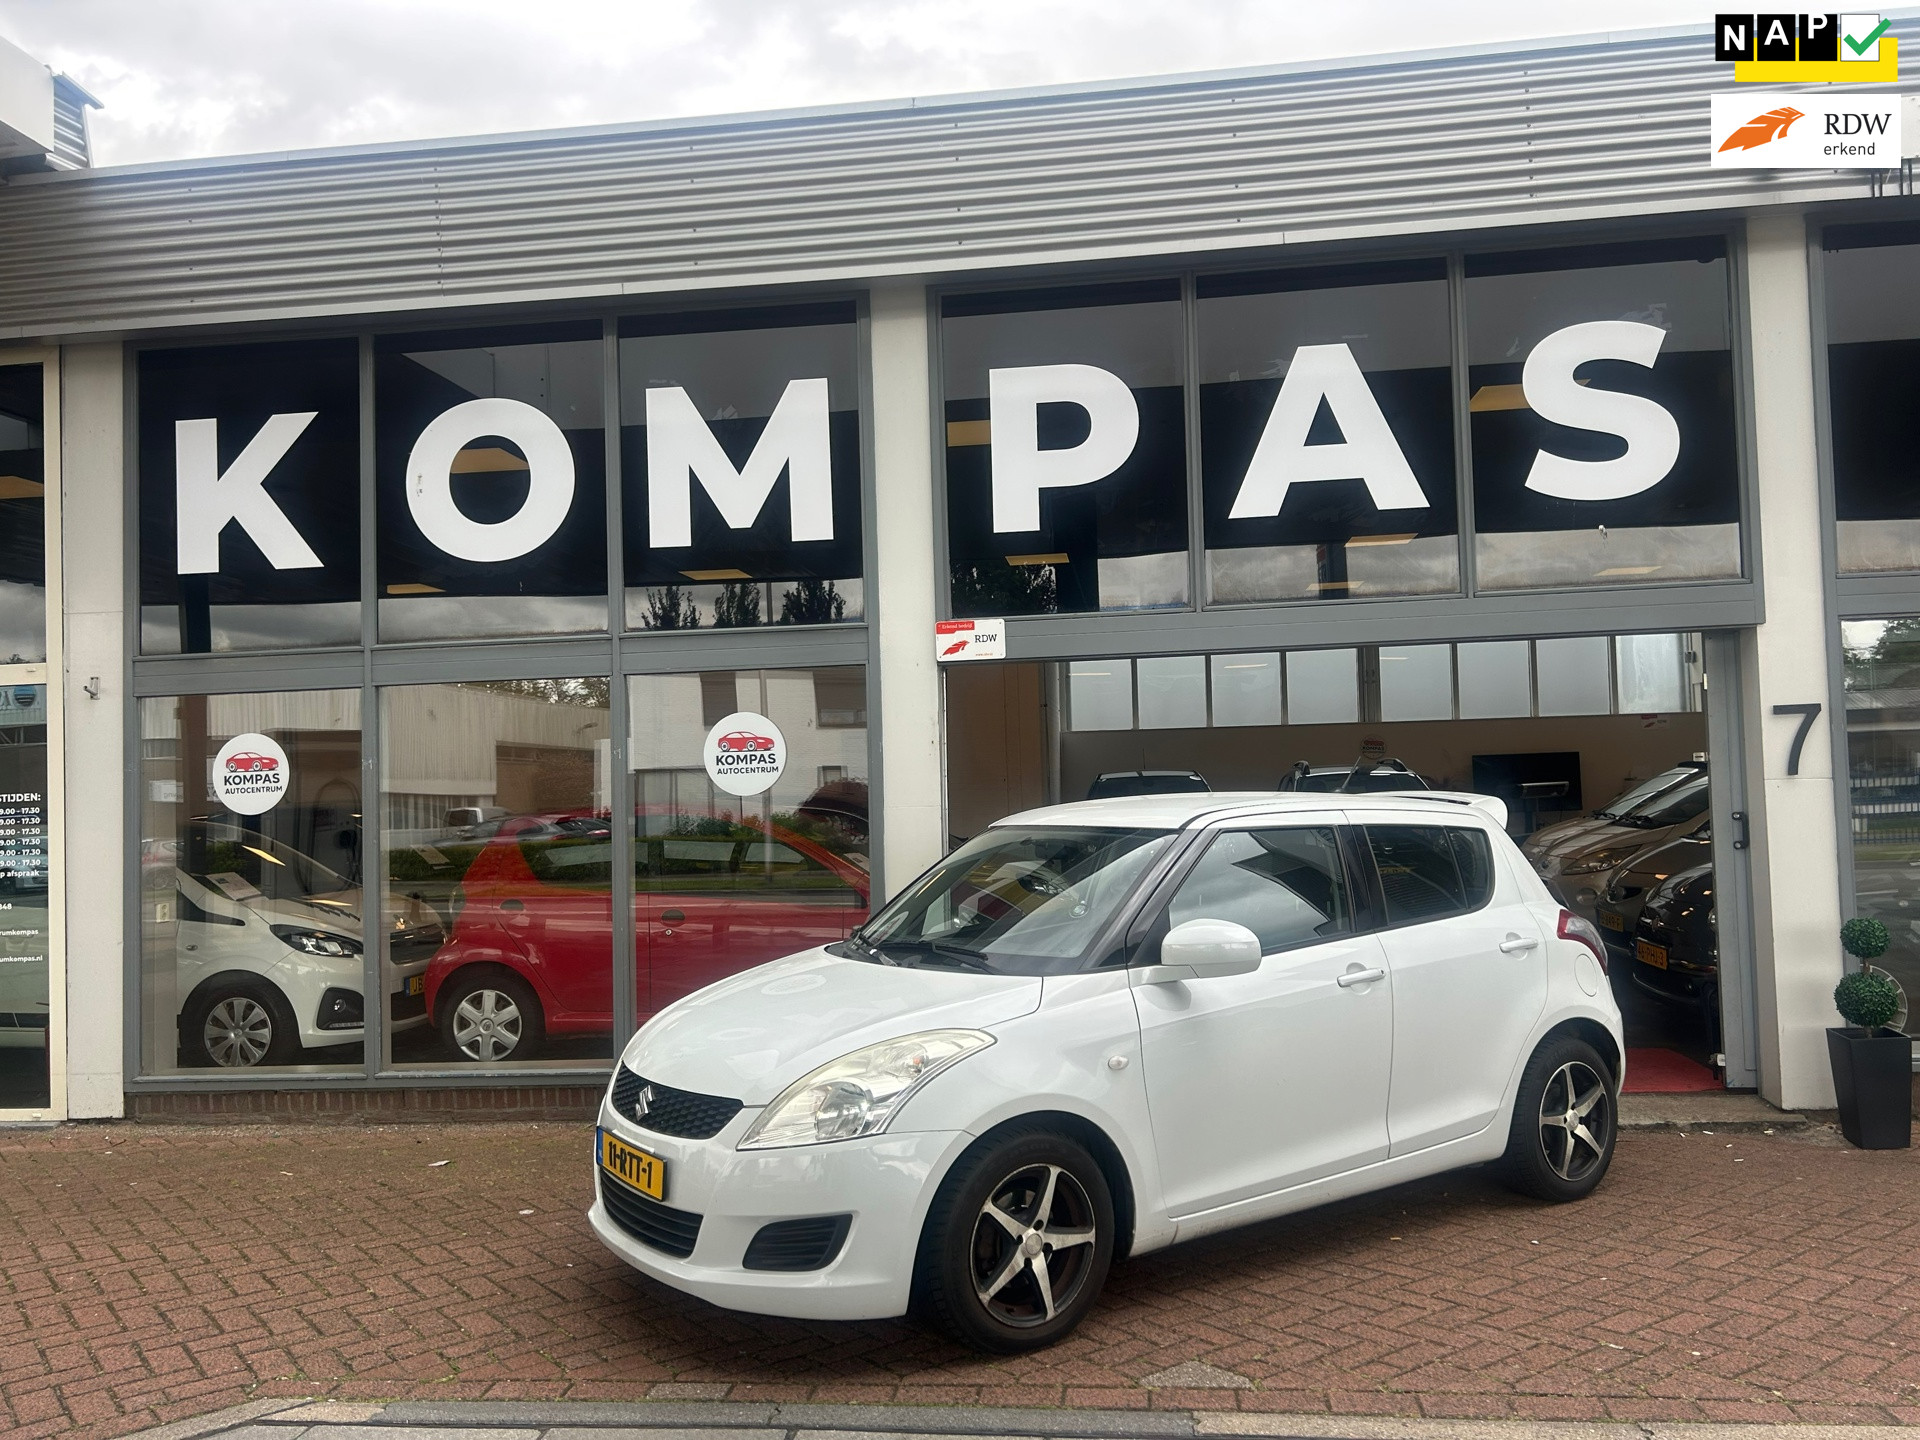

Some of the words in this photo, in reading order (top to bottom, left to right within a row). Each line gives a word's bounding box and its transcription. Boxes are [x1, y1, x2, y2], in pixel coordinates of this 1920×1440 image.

[175, 320, 1681, 575] KOMPAS
[974, 634, 998, 643] RDW
[1772, 703, 1822, 775] 7
[716, 753, 776, 766] KOMPAS
[717, 766, 779, 775] AUTOCENTRUM
[224, 773, 280, 786] KOMPAS
[225, 786, 282, 795] AUTOCENTRUM
[0, 793, 41, 802] TIJDEN:
[21, 817, 41, 825] 17.30
[6, 869, 40, 878] afspraak
[608, 1141, 653, 1189] 11-RTT-1
